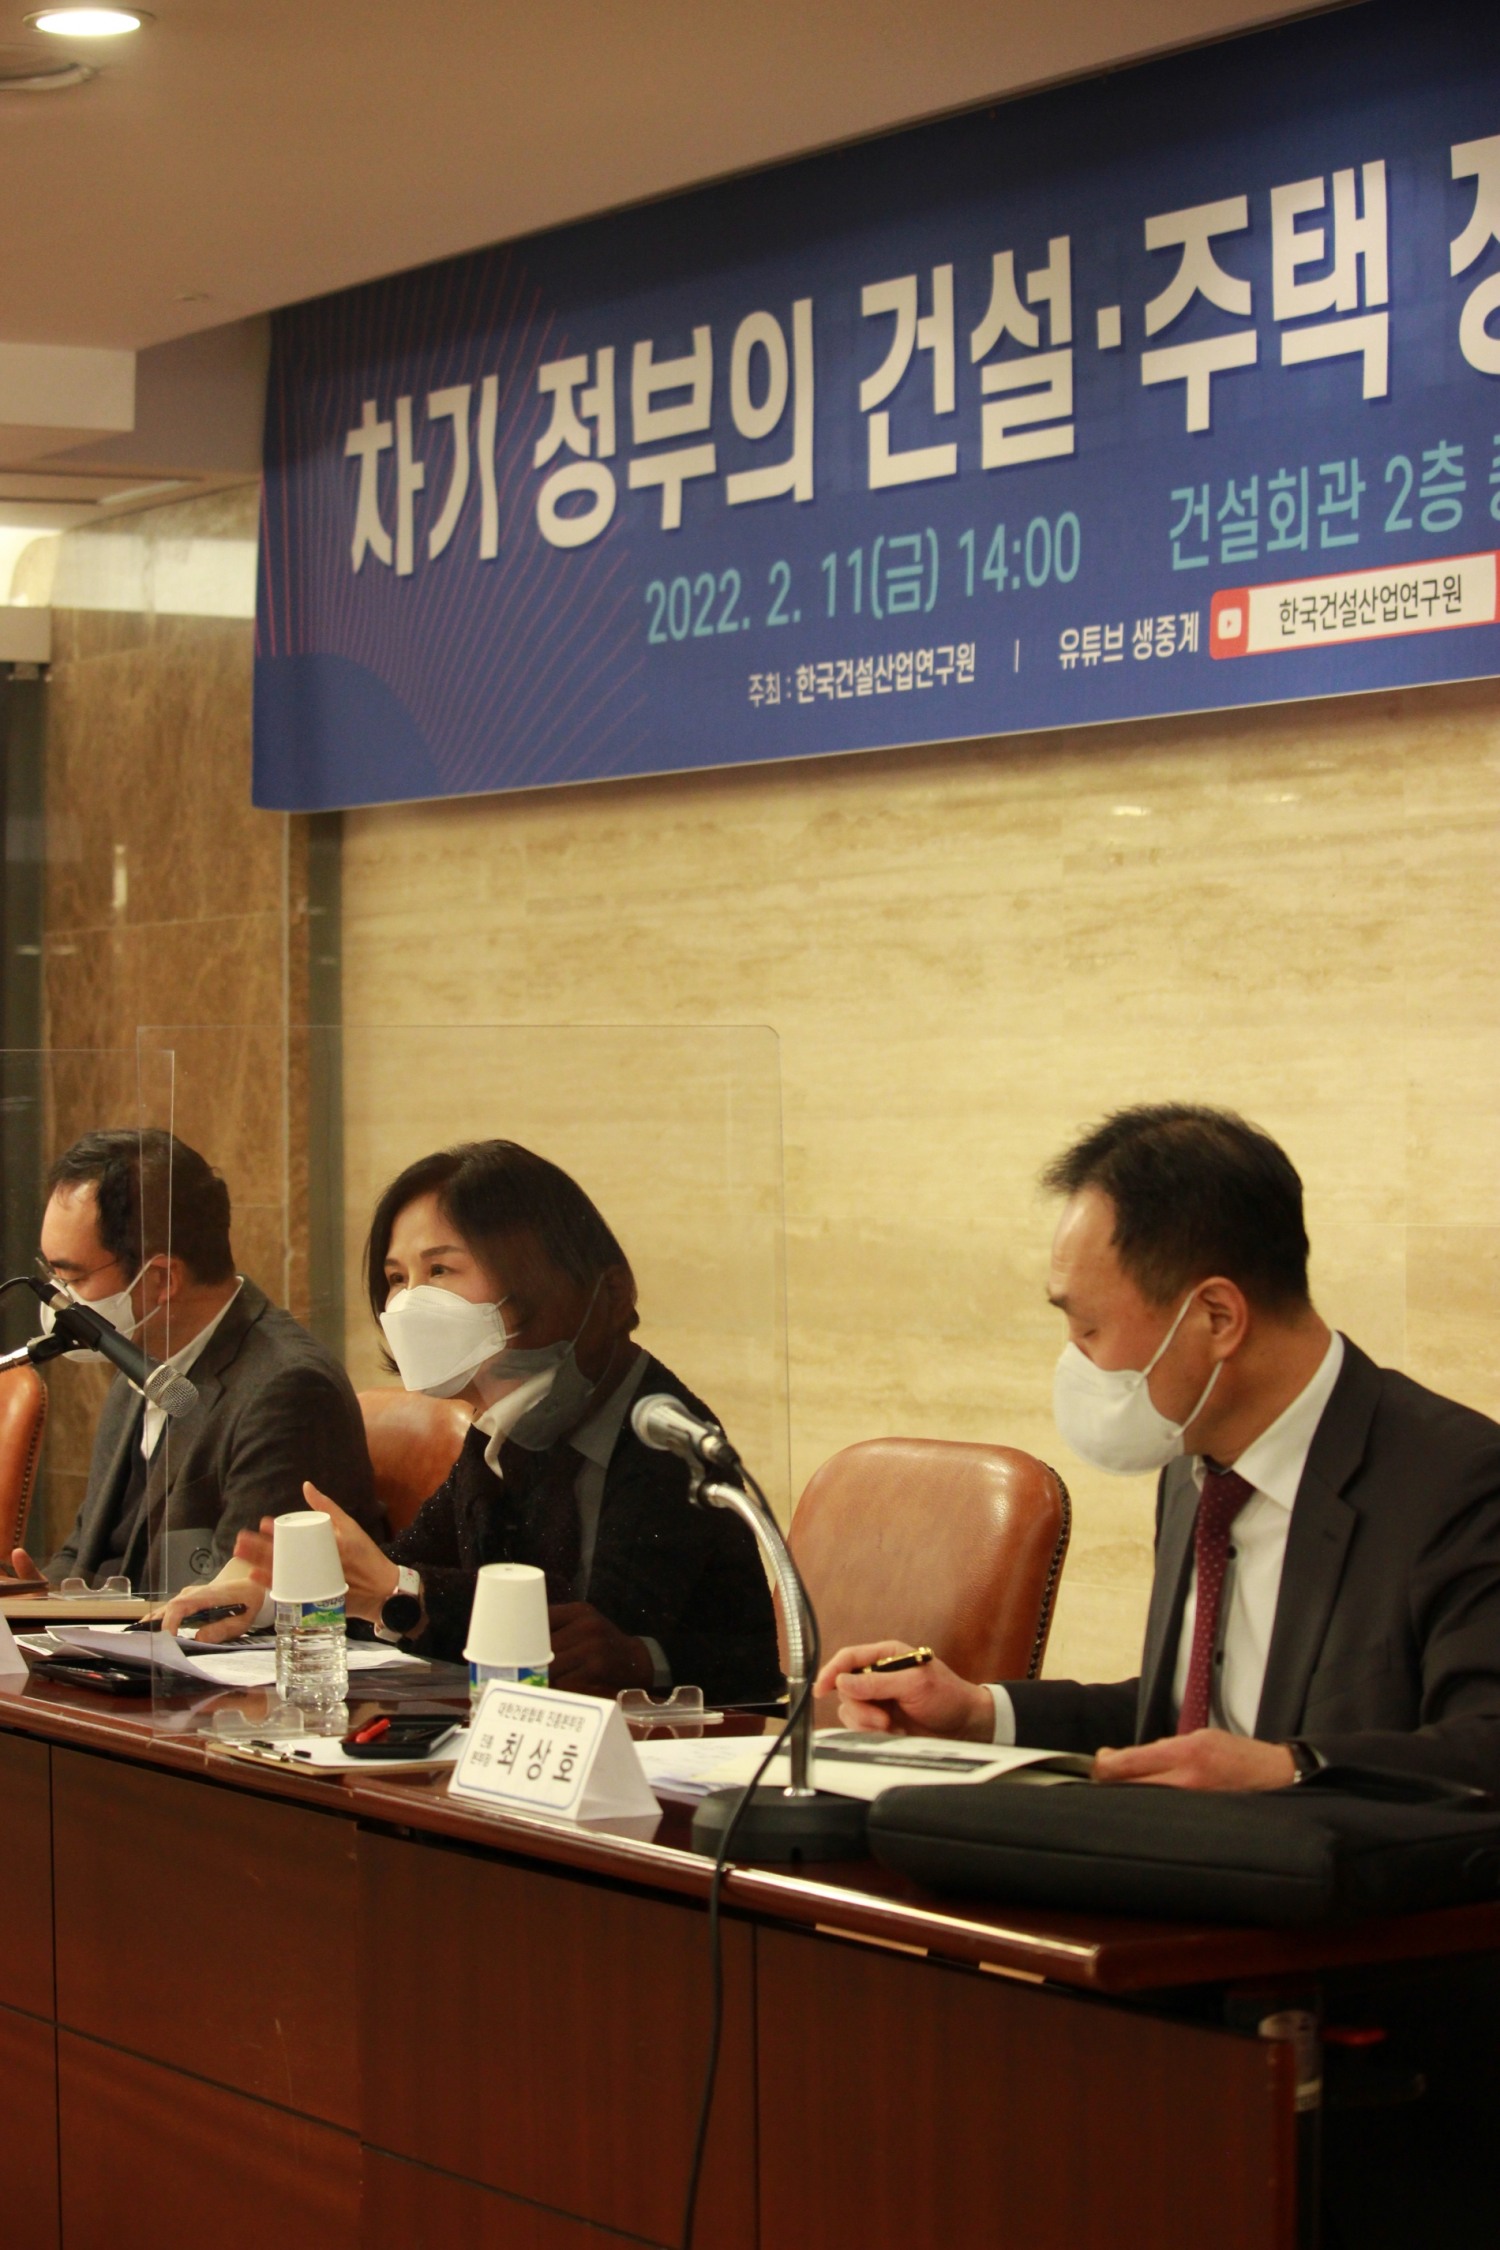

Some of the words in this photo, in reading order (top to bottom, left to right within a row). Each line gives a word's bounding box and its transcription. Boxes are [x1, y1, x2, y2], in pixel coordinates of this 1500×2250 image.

[345, 374, 499, 577] 차기
[533, 298, 814, 549] 정부의
[1168, 457, 1367, 572] 건설회관
[1384, 439, 1467, 533] 2층
[646, 568, 751, 645] 2022.
[766, 560, 802, 627] 2.
[821, 526, 939, 620] 11(금)
[958, 511, 1081, 598] 14:00
[1279, 574, 1463, 637] 한국건설산업연구원
[749, 671, 781, 708] 주최
[796, 642, 976, 704] 한국건설산업연구원
[1058, 622, 1125, 670] 유튜브
[1131, 611, 1200, 661] 생중계
